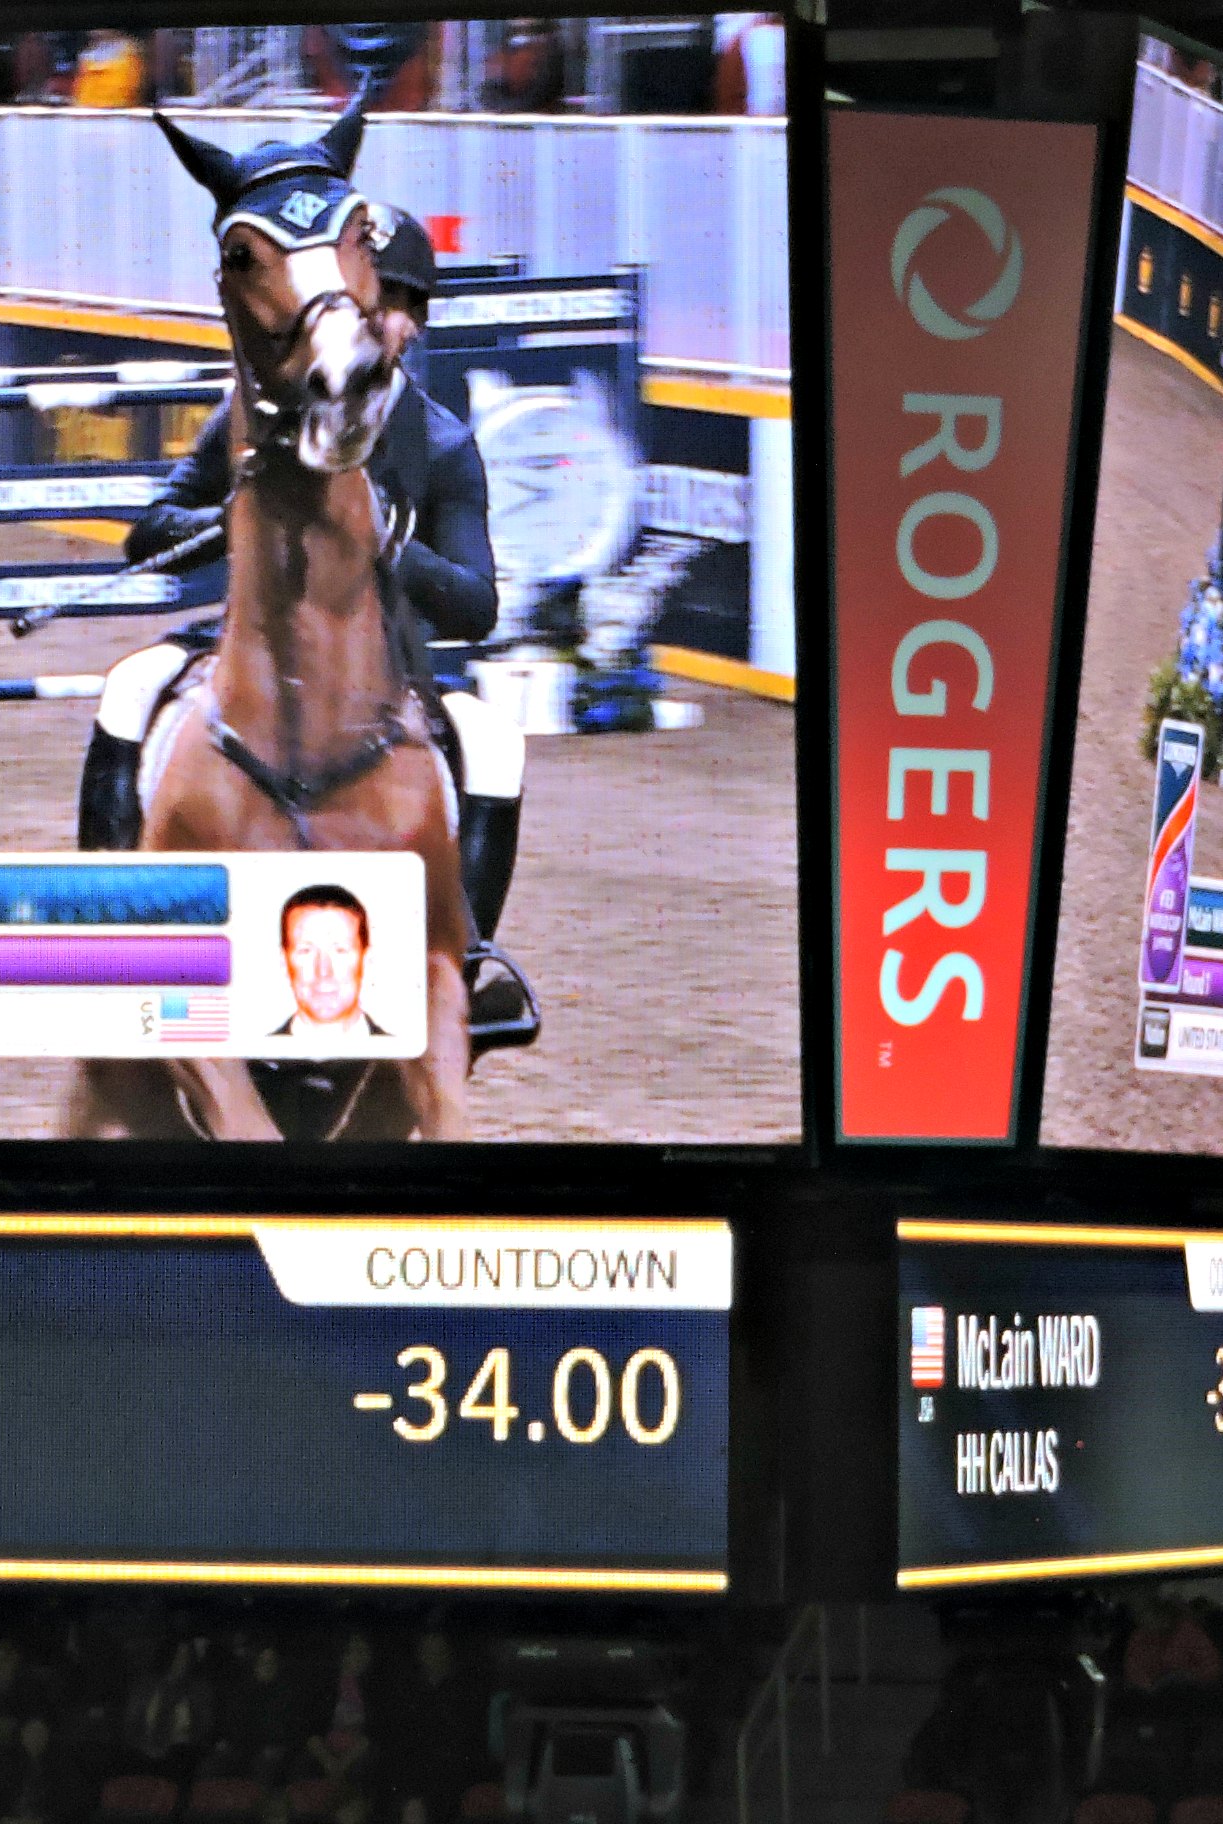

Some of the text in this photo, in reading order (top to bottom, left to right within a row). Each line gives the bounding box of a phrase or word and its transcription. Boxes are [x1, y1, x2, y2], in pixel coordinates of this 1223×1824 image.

[879, 393, 1004, 1027] ROGERS
[366, 1247, 677, 1290] COUNTDOWN
[957, 1312, 1102, 1391] McLain WARD
[352, 1345, 681, 1446] -34.00
[957, 1428, 1061, 1496] HH CALLAS
